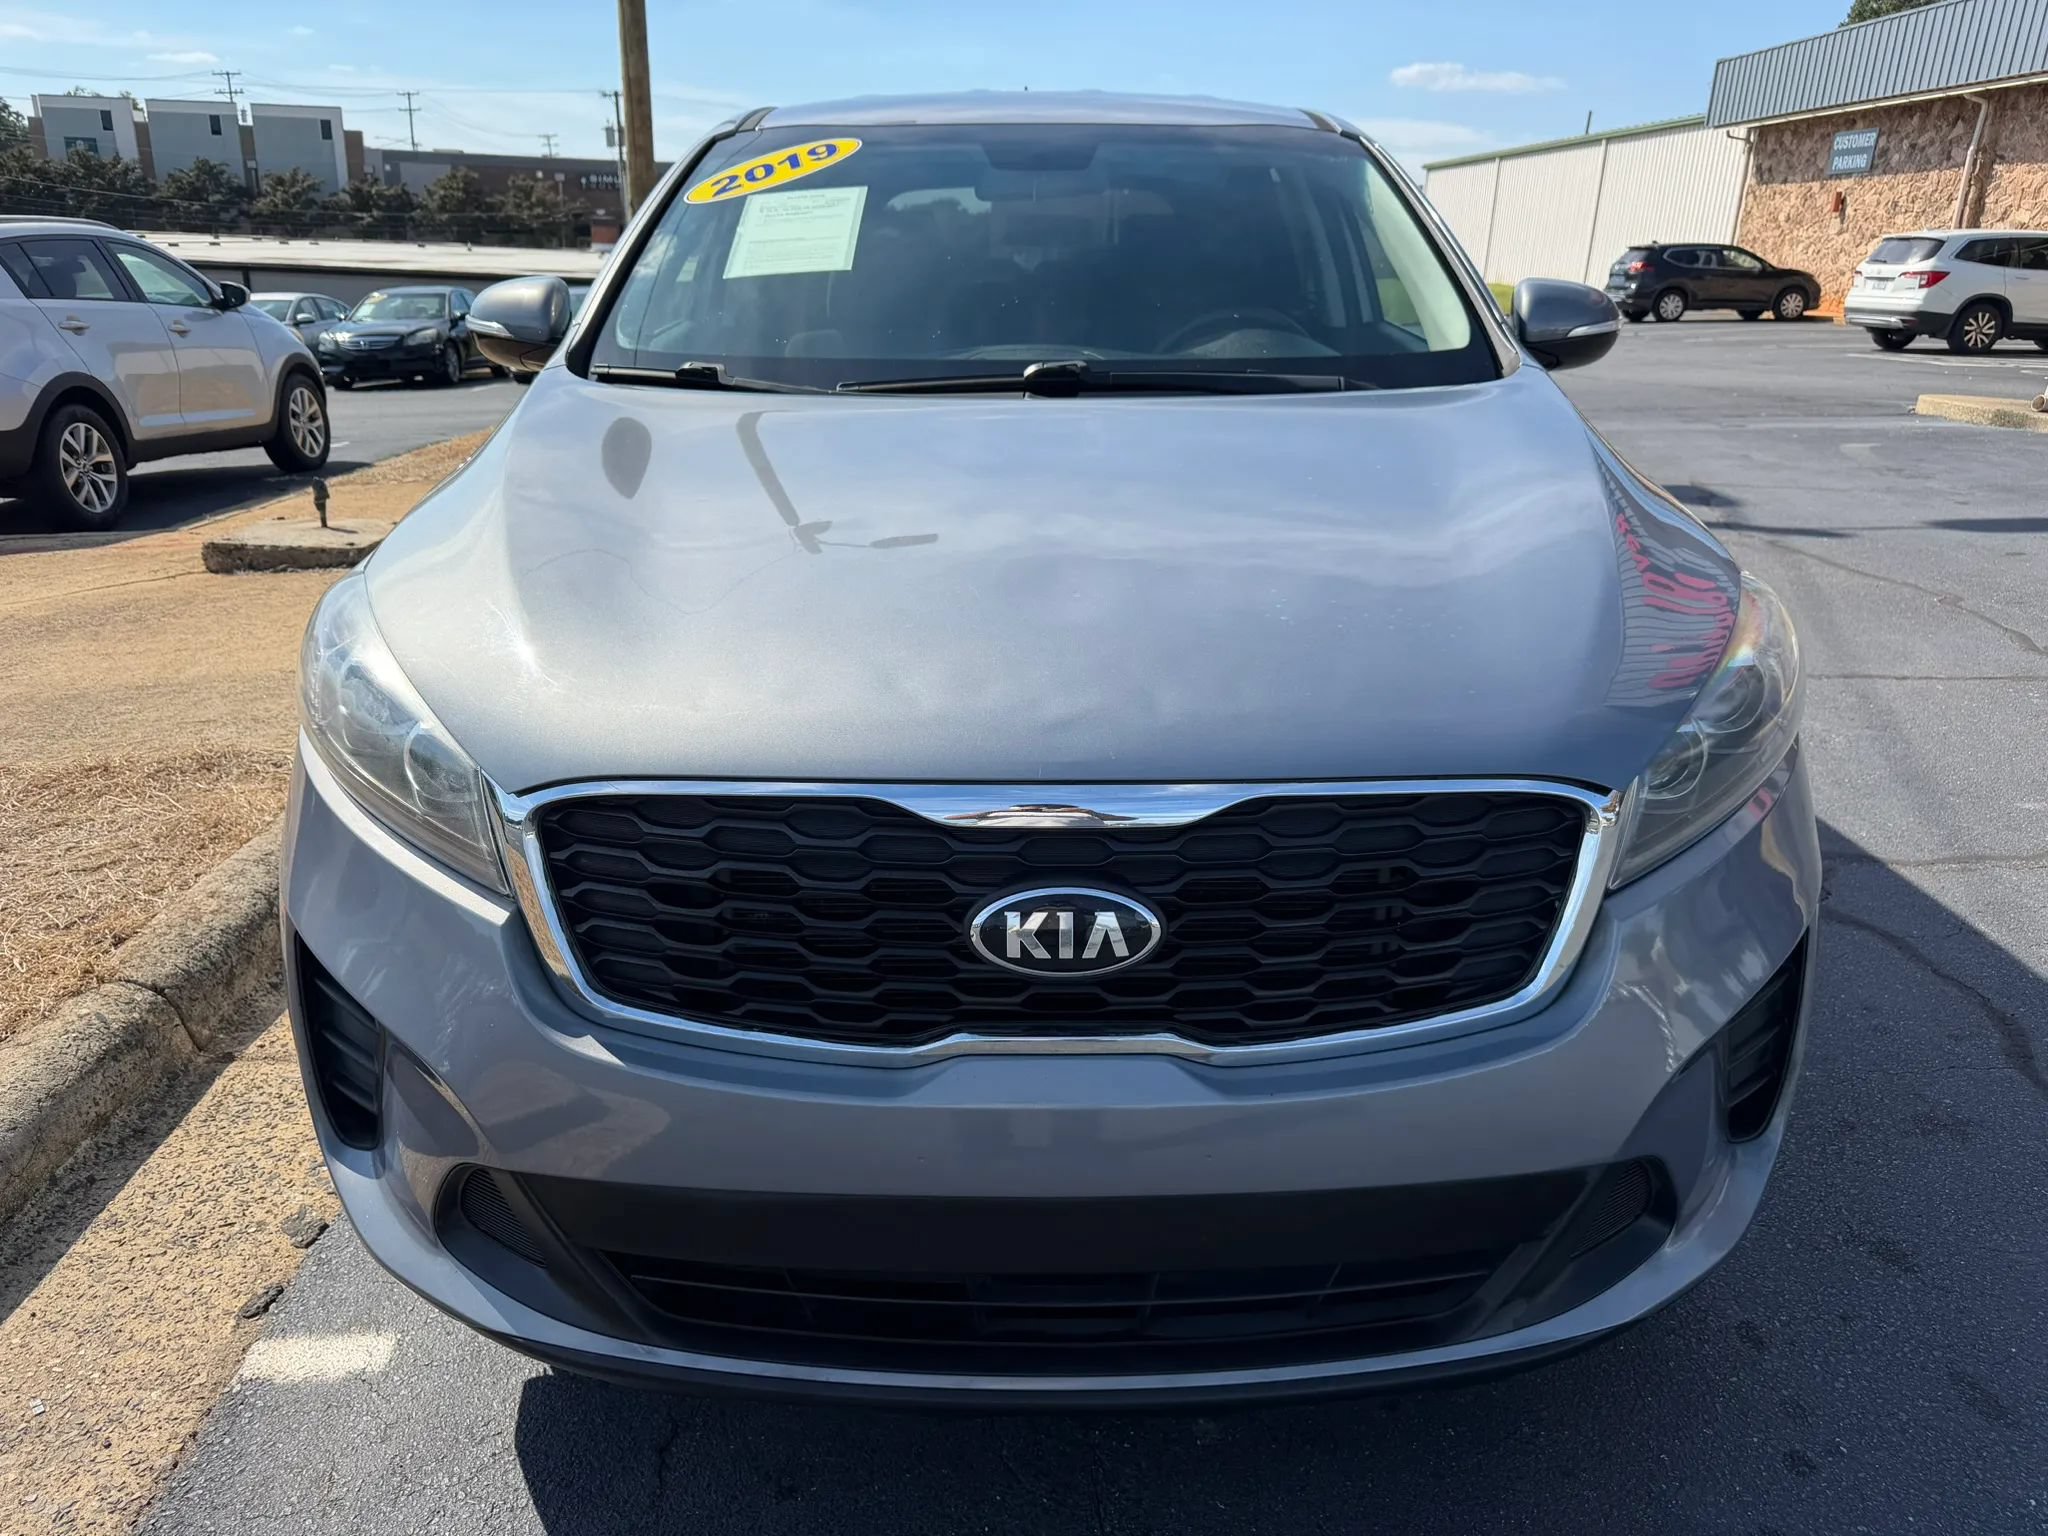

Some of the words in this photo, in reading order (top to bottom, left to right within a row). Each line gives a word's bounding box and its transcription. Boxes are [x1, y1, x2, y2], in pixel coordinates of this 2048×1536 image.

[1834, 132, 1876, 151] CUSTOMER
[710, 143, 838, 198] 2019
[1832, 153, 1868, 171] PARKING
[1003, 911, 1130, 960] KIA
